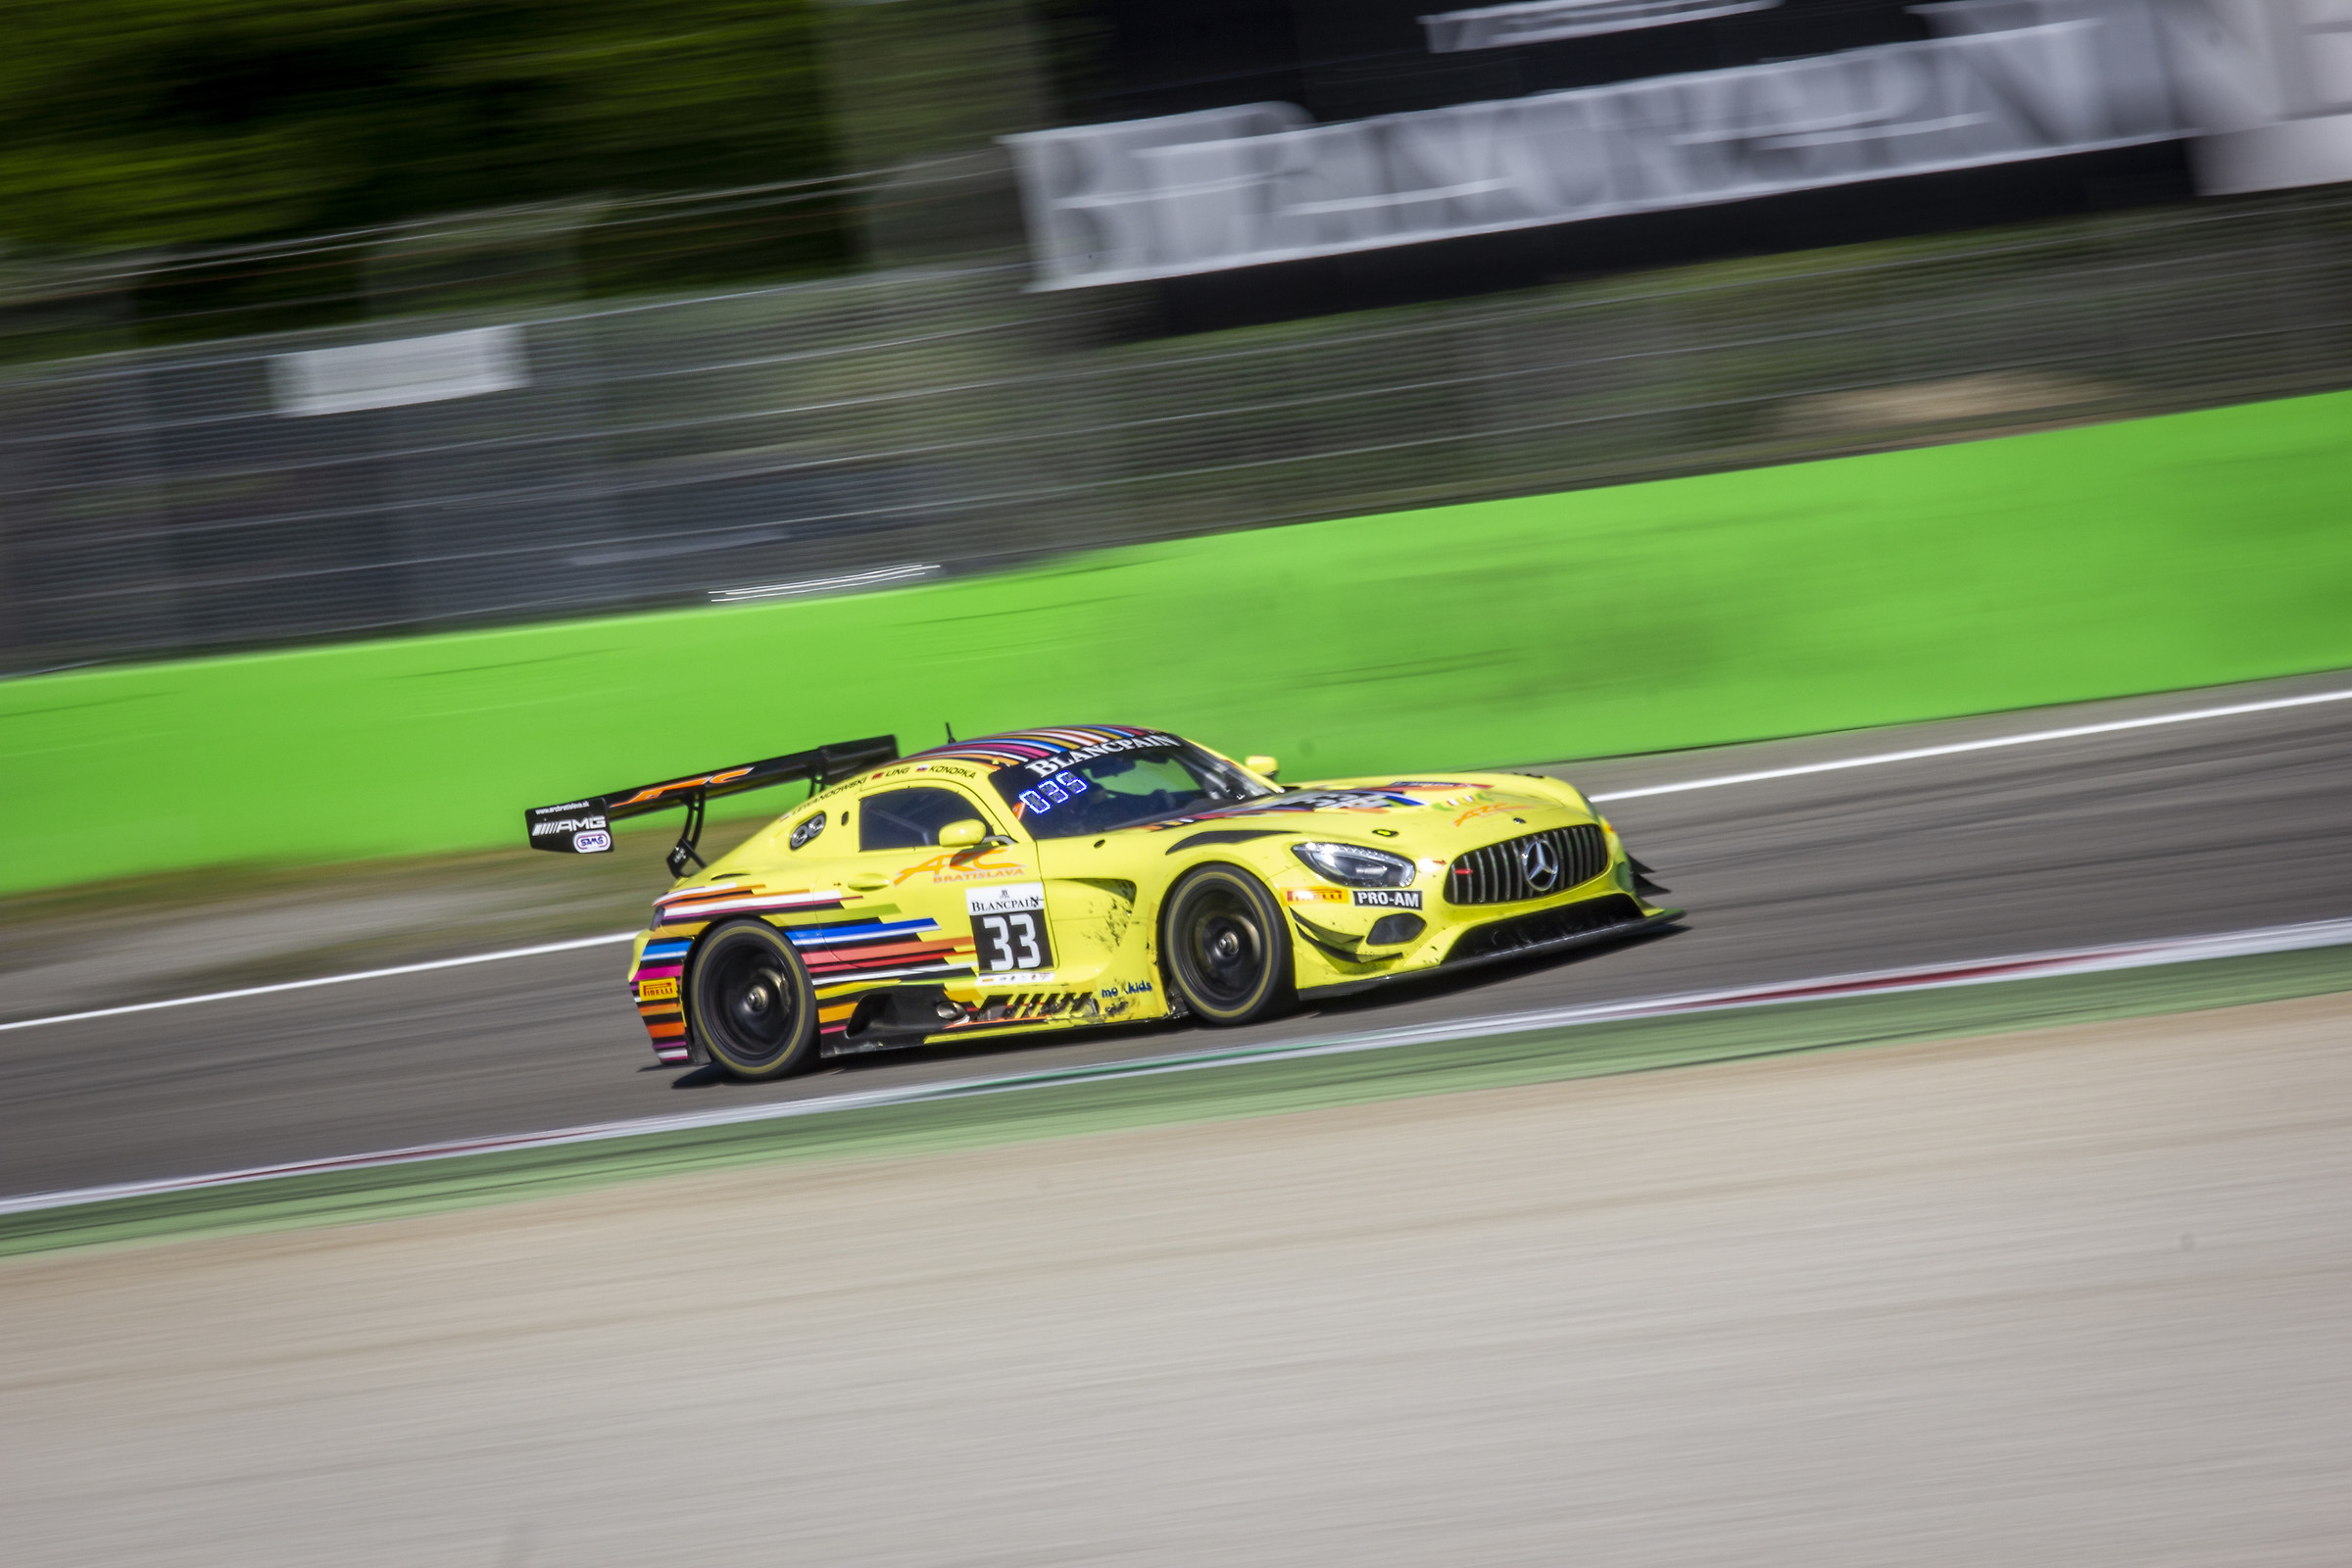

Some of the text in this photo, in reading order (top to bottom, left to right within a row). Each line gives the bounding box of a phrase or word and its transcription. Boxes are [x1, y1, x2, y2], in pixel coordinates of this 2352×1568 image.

[1024, 734, 1182, 778] BLANCPAIN
[885, 766, 910, 778] LING
[928, 764, 977, 780] KONOPKA
[792, 776, 868, 815] LEWANDOWSKI
[1018, 769, 1089, 815] 035
[556, 815, 607, 834] AMG
[933, 868, 1025, 884] BRATISLAVA
[1287, 888, 1343, 903] PELLI
[1357, 891, 1420, 908] PRO-AM
[971, 896, 1040, 912] BLANCPAIN
[983, 912, 1042, 972] 33
[643, 982, 673, 997] PIRELLI
